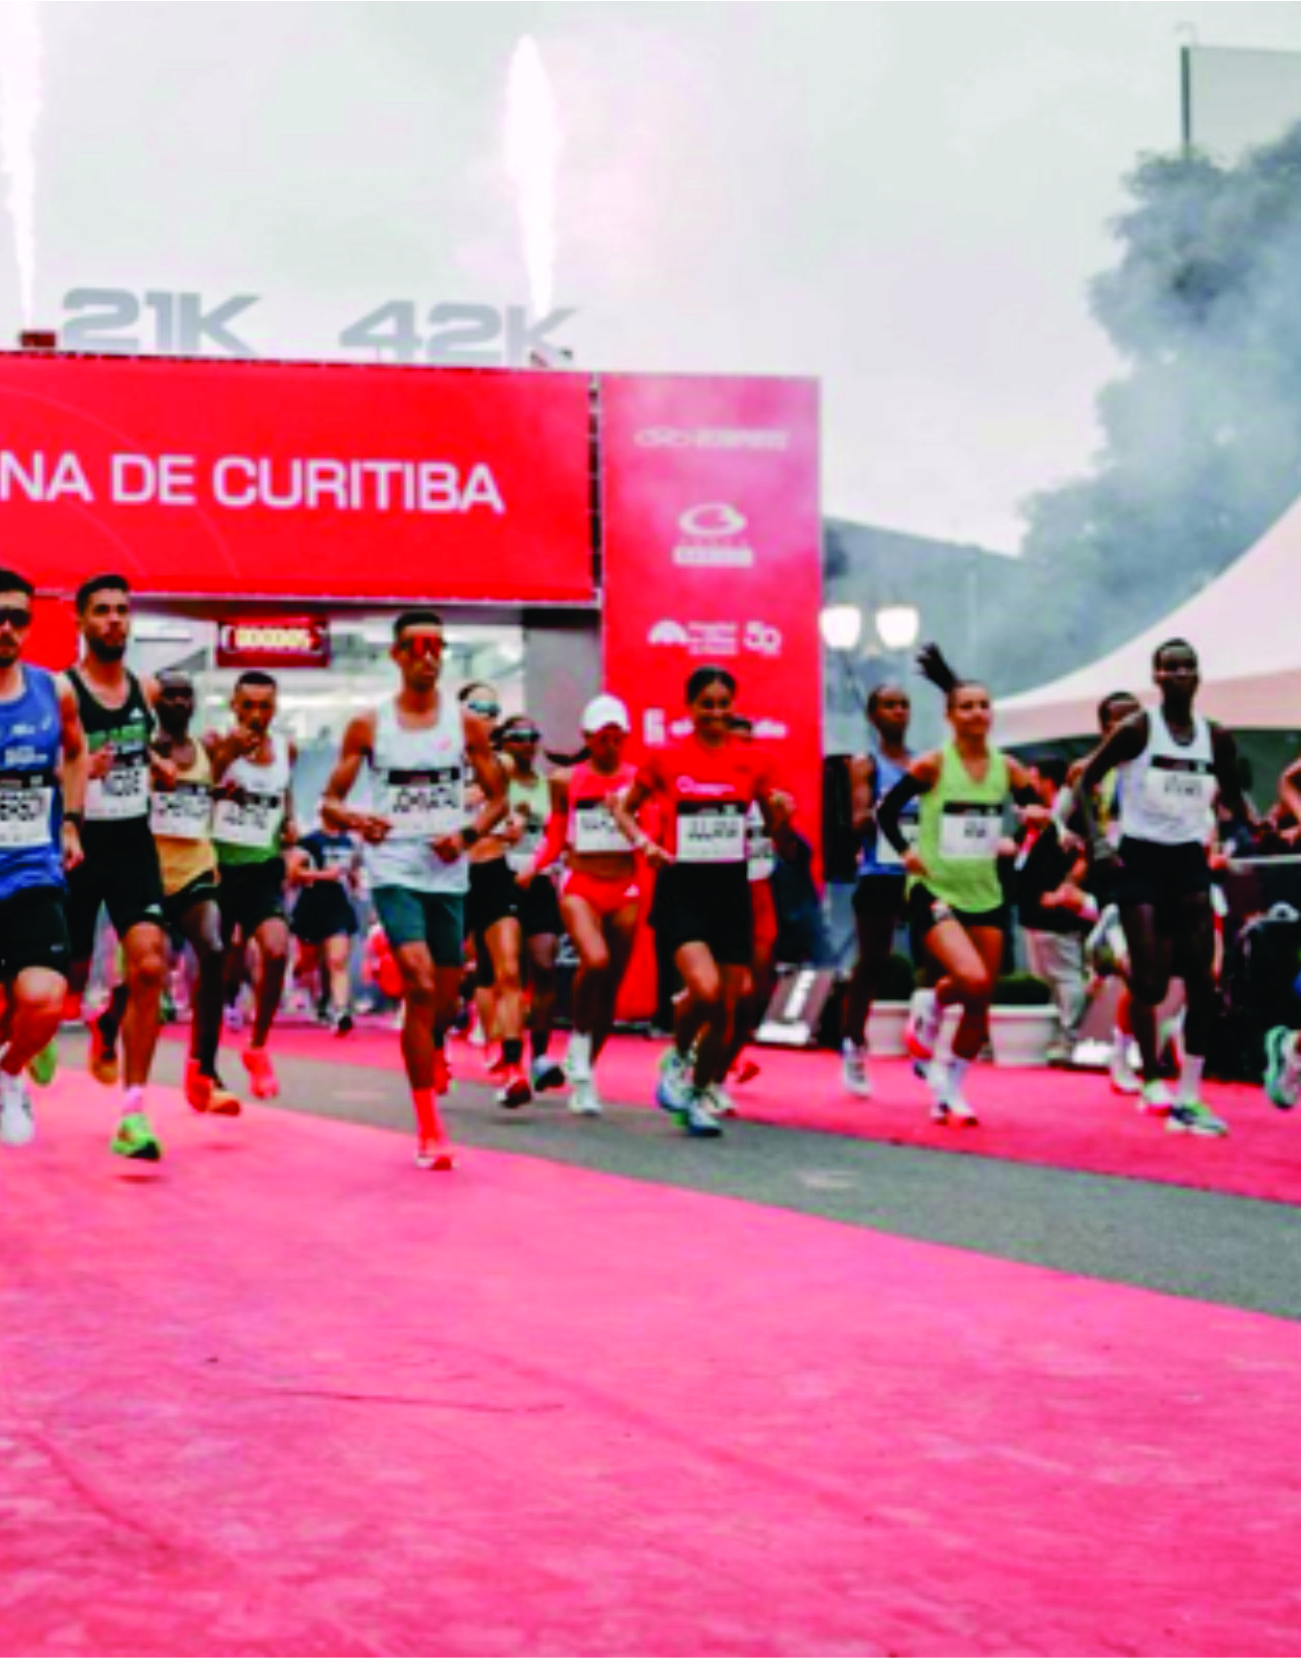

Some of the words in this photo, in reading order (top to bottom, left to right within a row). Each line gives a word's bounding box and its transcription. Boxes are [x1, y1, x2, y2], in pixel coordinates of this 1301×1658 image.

[62, 287, 263, 357] 21K
[339, 300, 578, 367] 42K
[110, 453, 195, 505] DE
[212, 454, 506, 514] CURITIBA
